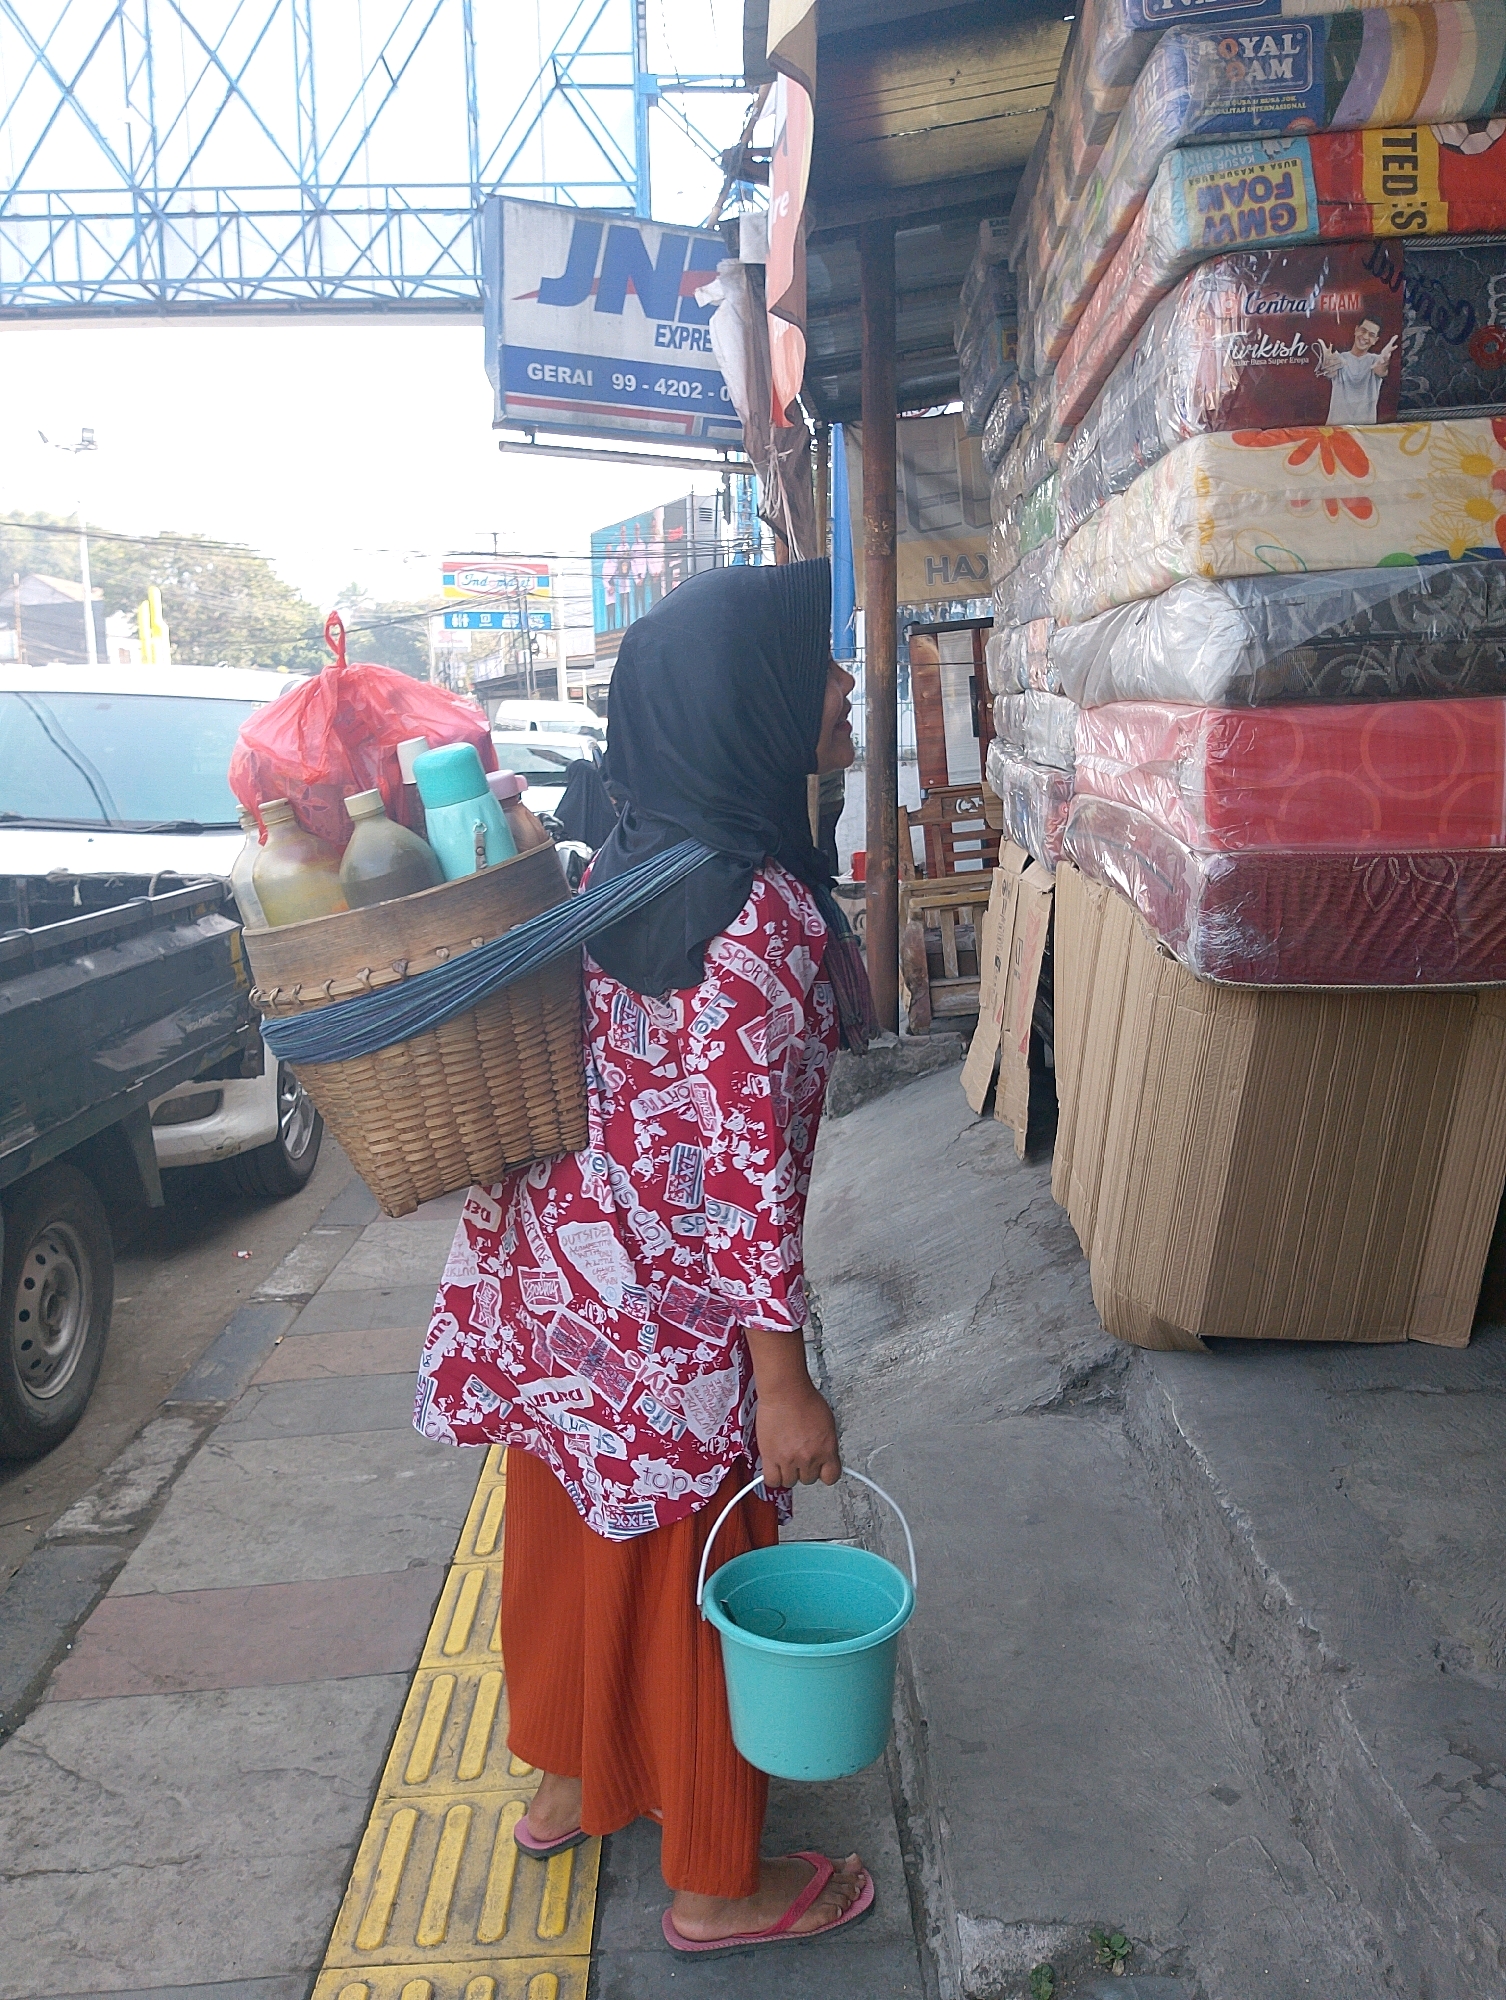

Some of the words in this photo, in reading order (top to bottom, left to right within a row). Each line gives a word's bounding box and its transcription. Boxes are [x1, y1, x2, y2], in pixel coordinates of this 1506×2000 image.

[1198, 33, 1300, 60] ROYAL
[1219, 166, 1255, 180] KASUR
[1270, 159, 1298, 171] BUSA
[1196, 171, 1294, 214] FOAM
[1202, 202, 1298, 246] GMW
[1320, 293, 1361, 312] FOAM
[526, 362, 593, 387] GERAI
[654, 378, 703, 399] 4202
[694, 992, 737, 1036] Life
[707, 1200, 756, 1238] Life
[470, 1380, 511, 1418] Life
[642, 1396, 687, 1440] Life
[643, 1466, 689, 1493] top
[615, 1511, 650, 1527] XXL
